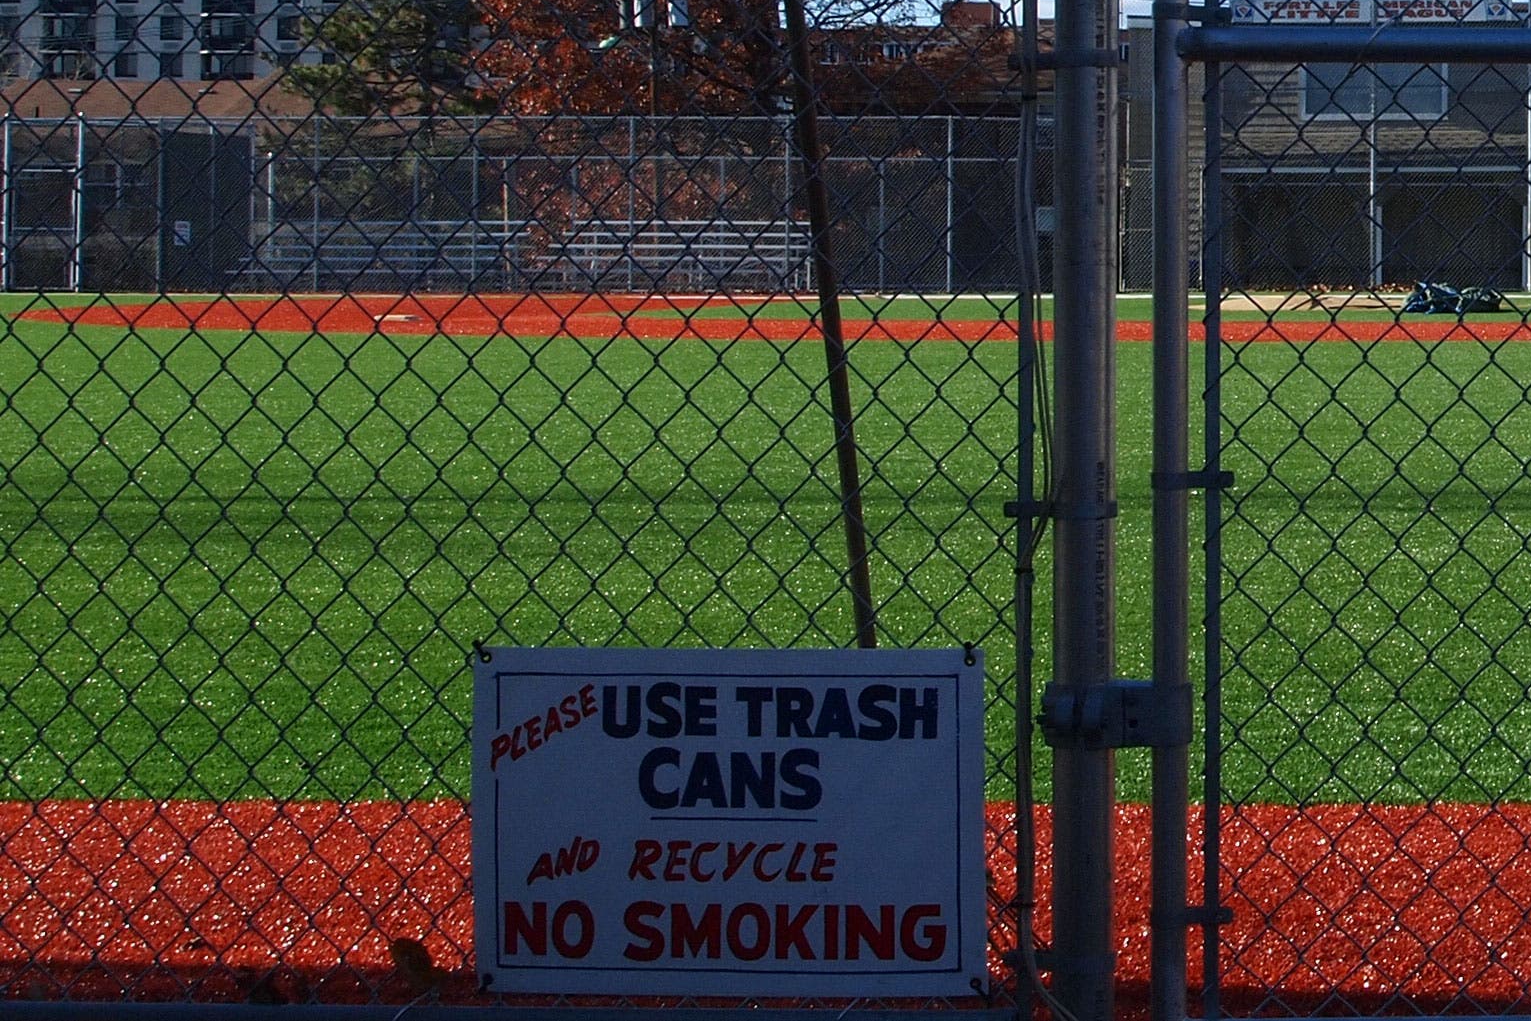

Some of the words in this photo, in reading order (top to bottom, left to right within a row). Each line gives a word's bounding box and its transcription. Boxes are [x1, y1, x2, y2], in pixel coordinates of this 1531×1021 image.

[1377, 0, 1473, 9] MERICAN
[489, 683, 598, 772] PLEASE
[602, 682, 717, 740] USE
[736, 684, 939, 741] TRASH
[638, 746, 823, 811] CANS
[527, 836, 600, 886] AND
[627, 840, 838, 882] RECYCLE
[504, 899, 595, 959] NO
[623, 901, 947, 962] SMOKING
